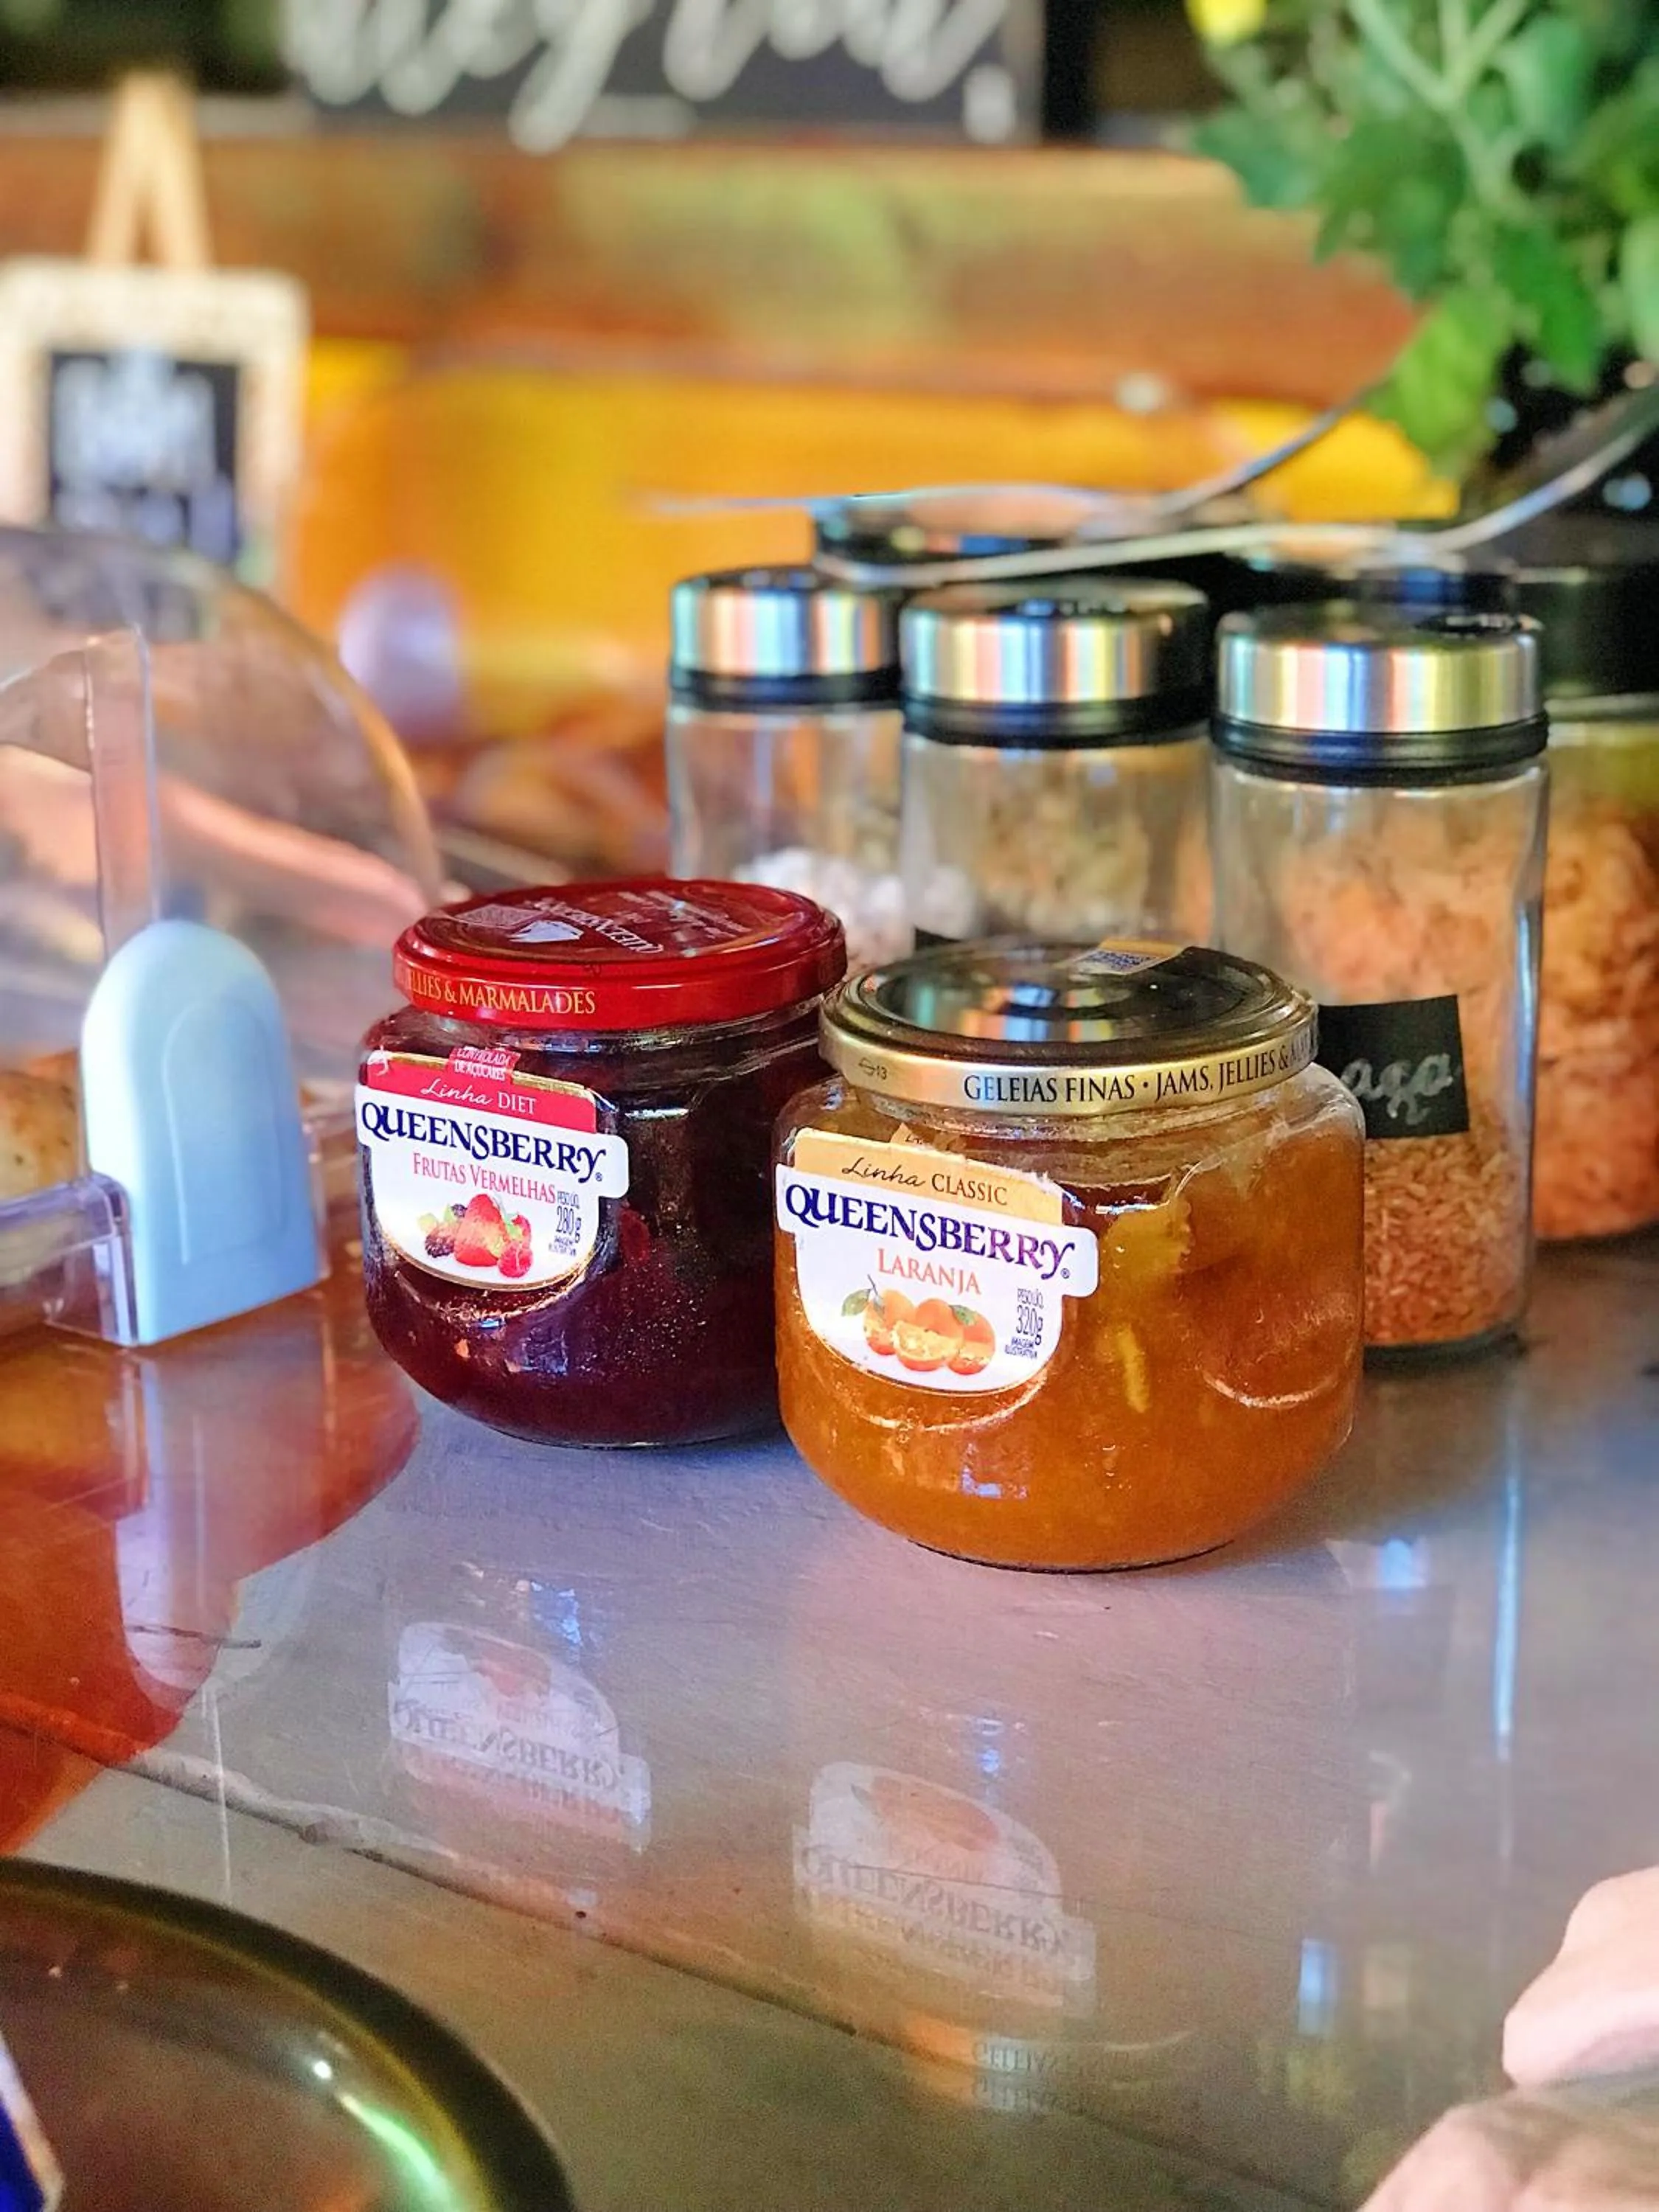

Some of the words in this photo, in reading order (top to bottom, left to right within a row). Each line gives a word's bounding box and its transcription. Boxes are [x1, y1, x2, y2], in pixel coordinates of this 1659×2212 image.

[445, 981, 456, 1004] &
[459, 983, 596, 1015] MARMALADES
[420, 1078, 493, 1105] Linha
[497, 1091, 537, 1115] DIET
[964, 1074, 1057, 1102] GELEIAS
[1065, 1074, 1135, 1102] FINAS
[1218, 1048, 1276, 1095] JELLIES
[1278, 1045, 1289, 1070] &
[362, 1102, 607, 1184] QUEENSBERRY
[841, 1156, 928, 1188] Linha
[931, 1173, 1008, 1206] CLASSIC
[785, 1183, 1076, 1280] QUEENSBERRY
[877, 1248, 981, 1295] LARANJA
